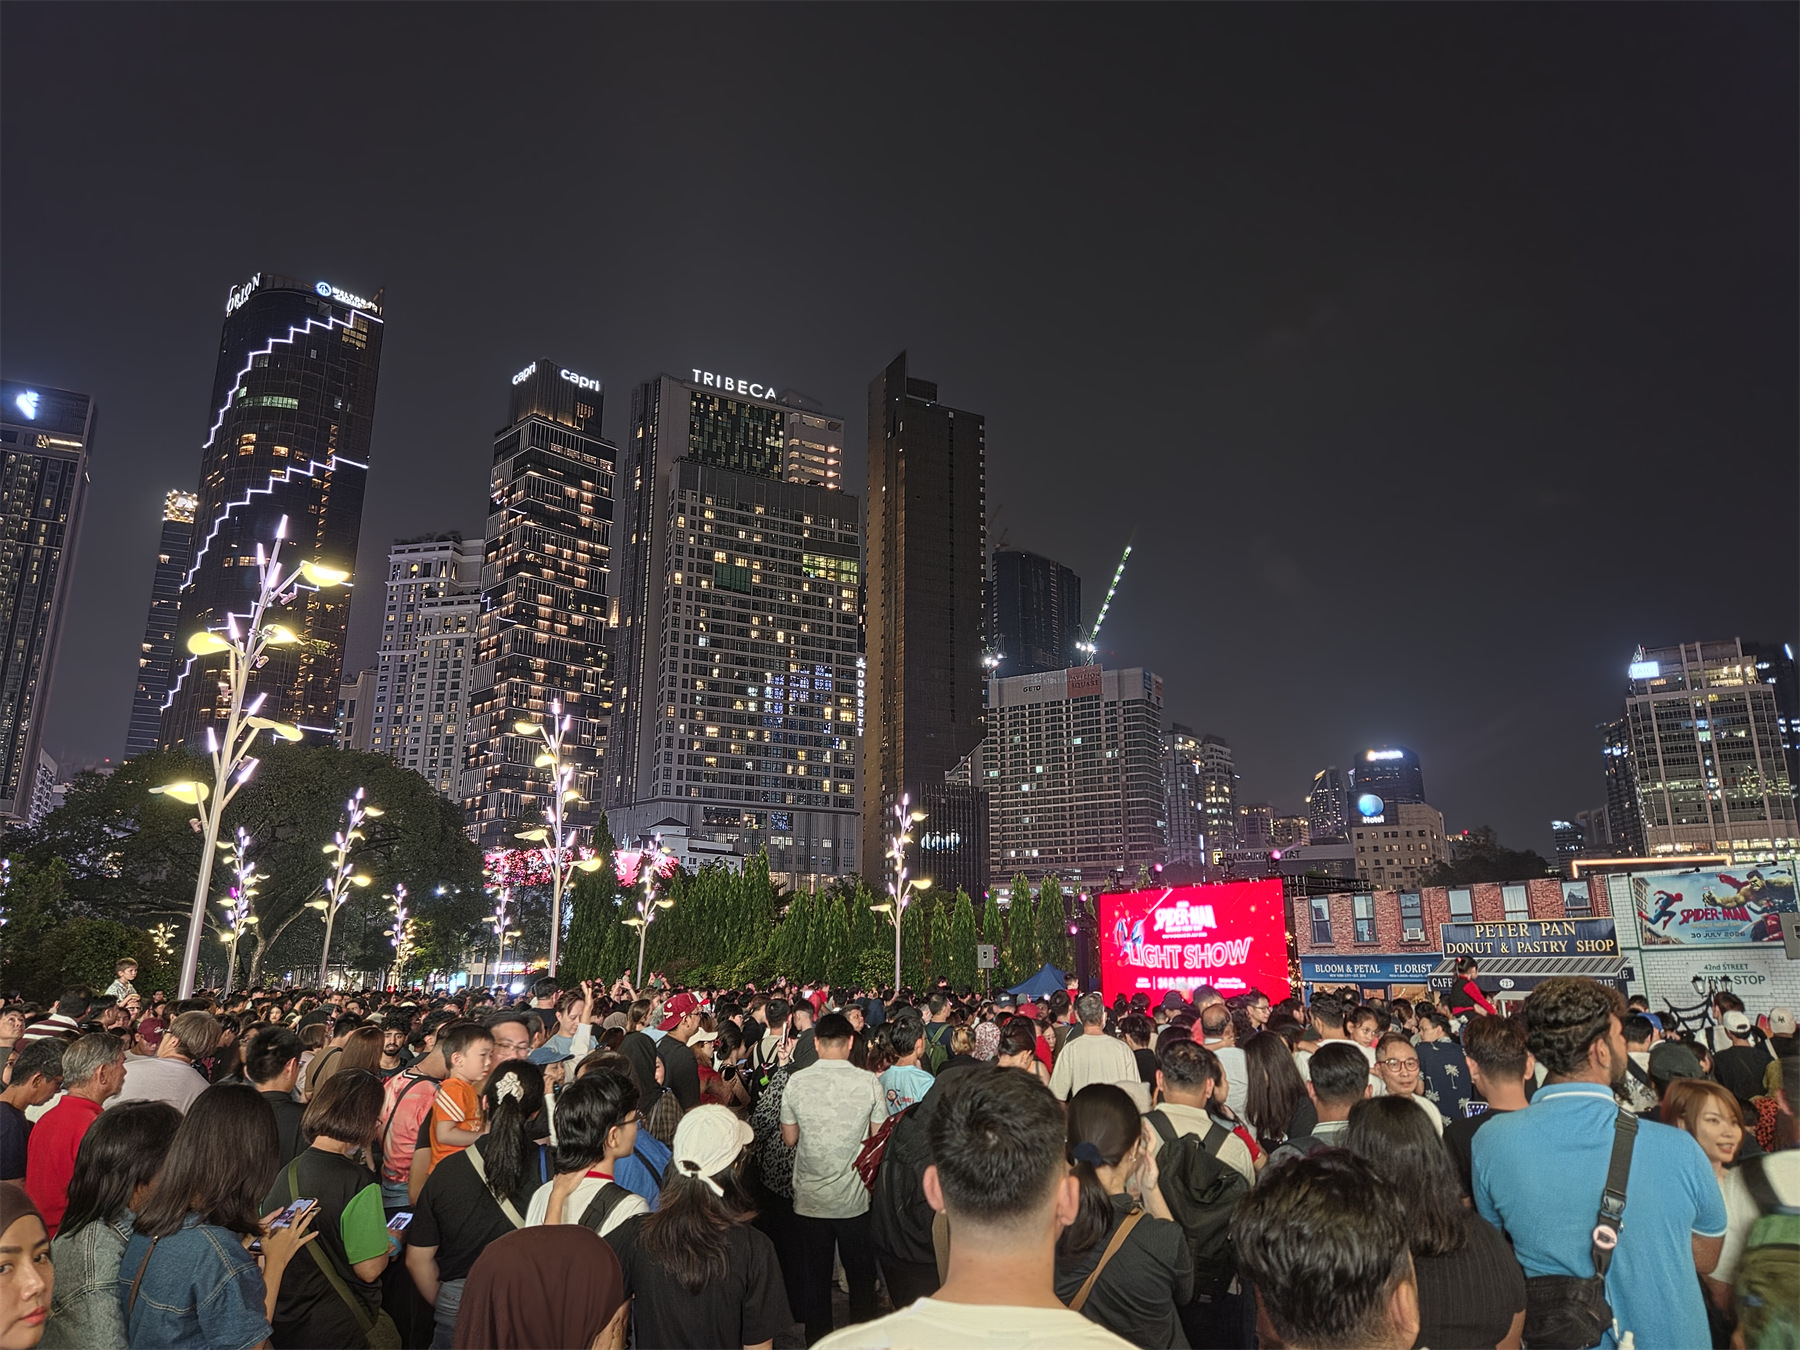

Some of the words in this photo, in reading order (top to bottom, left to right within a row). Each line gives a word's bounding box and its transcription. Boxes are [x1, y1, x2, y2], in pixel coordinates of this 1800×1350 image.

[512, 361, 536, 385] capri
[560, 369, 600, 391] capri
[692, 368, 777, 400] TRIBECA
[1068, 671, 1101, 682] PAVILION
[1071, 680, 1100, 689] SQUARE
[856, 669, 865, 737] DORSETT
[1679, 905, 1753, 926] SPIDER-MAN
[1474, 922, 1531, 939] PETER
[1541, 921, 1577, 938] PAN
[1127, 942, 1182, 969] LIGHT
[1183, 937, 1252, 969] SHOW
[1446, 942, 1492, 955] DONUT
[1500, 942, 1510, 954] &
[1517, 940, 1568, 954] PASTRY
[1576, 938, 1615, 953] SHOP
[1314, 963, 1345, 974] BLOOM
[1346, 963, 1353, 974] &
[1354, 963, 1381, 974] PETAL
[1394, 963, 1433, 974] FLORIST
[1722, 963, 1749, 971] STREET
[1501, 980, 1512, 988] 727
[1734, 975, 1766, 985] STOP
